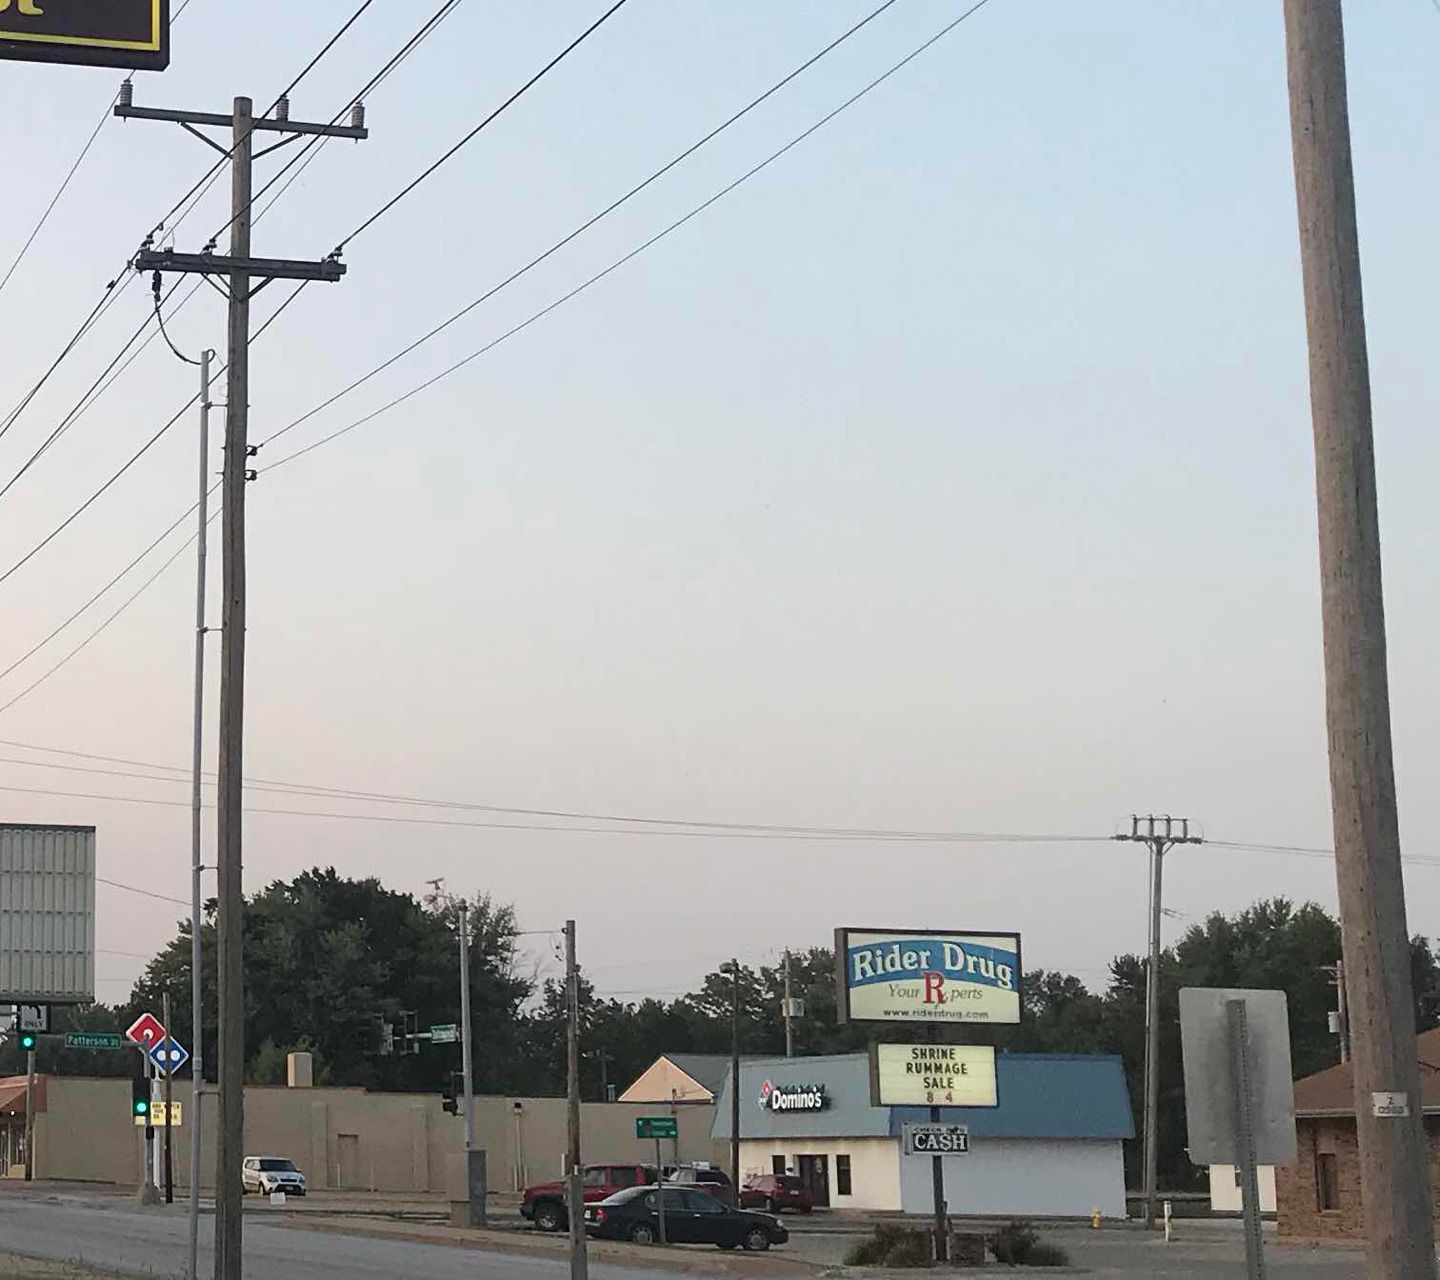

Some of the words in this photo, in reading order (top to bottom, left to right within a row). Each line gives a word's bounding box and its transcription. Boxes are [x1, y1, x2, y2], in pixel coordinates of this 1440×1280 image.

[852, 943, 931, 982] Rider
[942, 942, 1014, 990] Drug
[888, 984, 921, 999] Your
[911, 1047, 956, 1060] SHRINE
[906, 1062, 968, 1075] RUMMAGE
[923, 1076, 955, 1089] SALE
[772, 1086, 822, 1110] Domino's
[945, 1090, 953, 1103] 4
[914, 1133, 966, 1151] CASH
